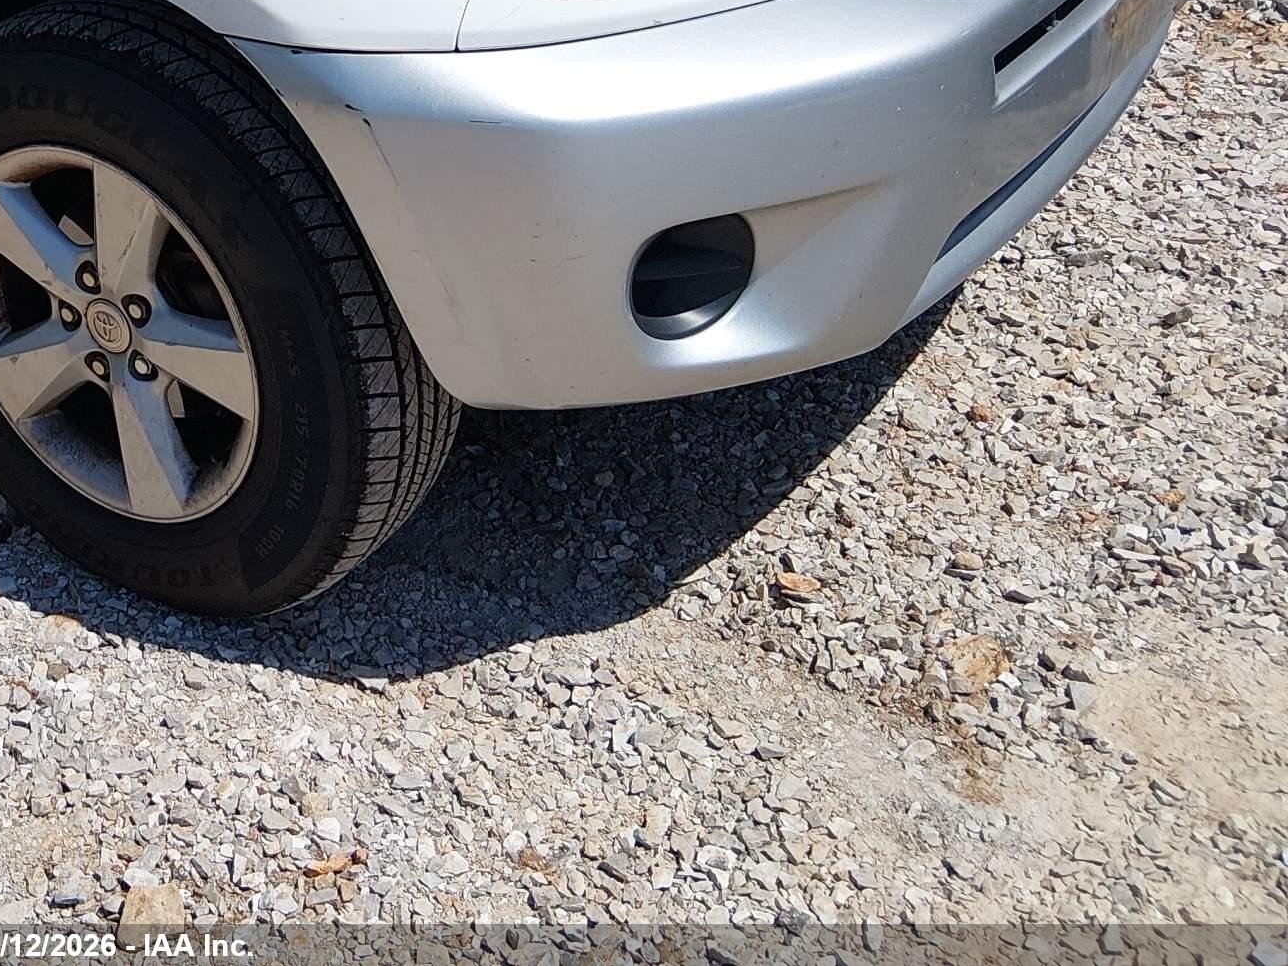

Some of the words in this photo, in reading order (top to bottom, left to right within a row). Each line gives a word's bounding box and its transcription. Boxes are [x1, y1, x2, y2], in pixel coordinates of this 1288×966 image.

[278, 328, 302, 379] M+S
[284, 401, 311, 512] 215/70R16
[254, 523, 286, 559] 100H
